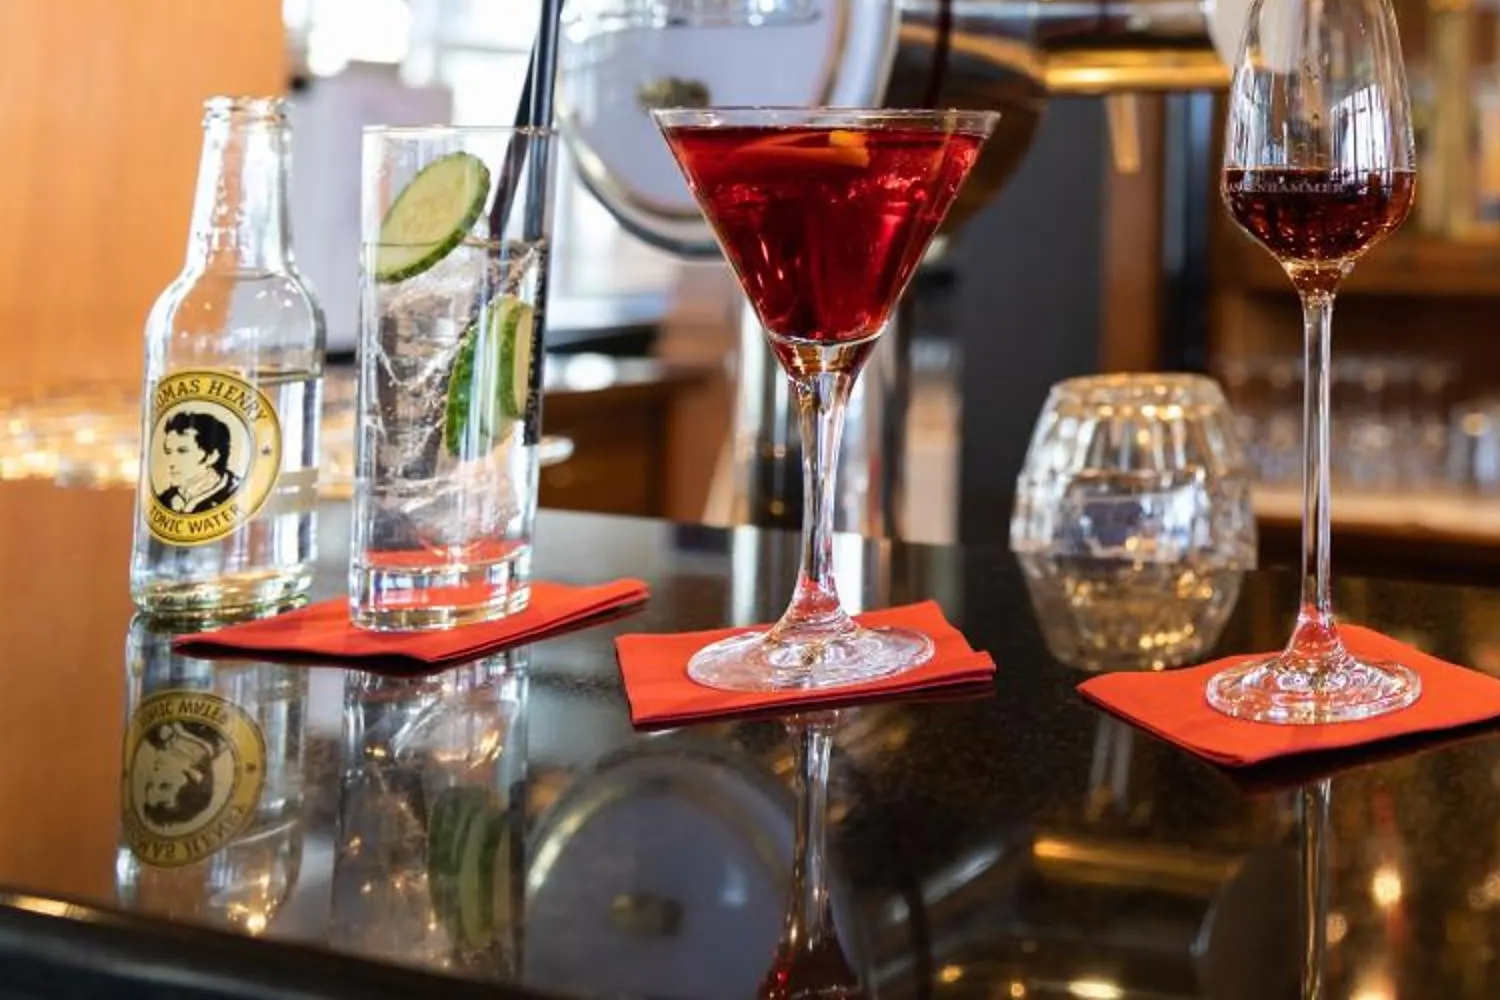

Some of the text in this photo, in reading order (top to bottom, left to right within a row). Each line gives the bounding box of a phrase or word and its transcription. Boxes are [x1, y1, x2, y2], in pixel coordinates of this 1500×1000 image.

[155, 378, 267, 423] OMAS HENRY
[150, 505, 185, 533] TONIC
